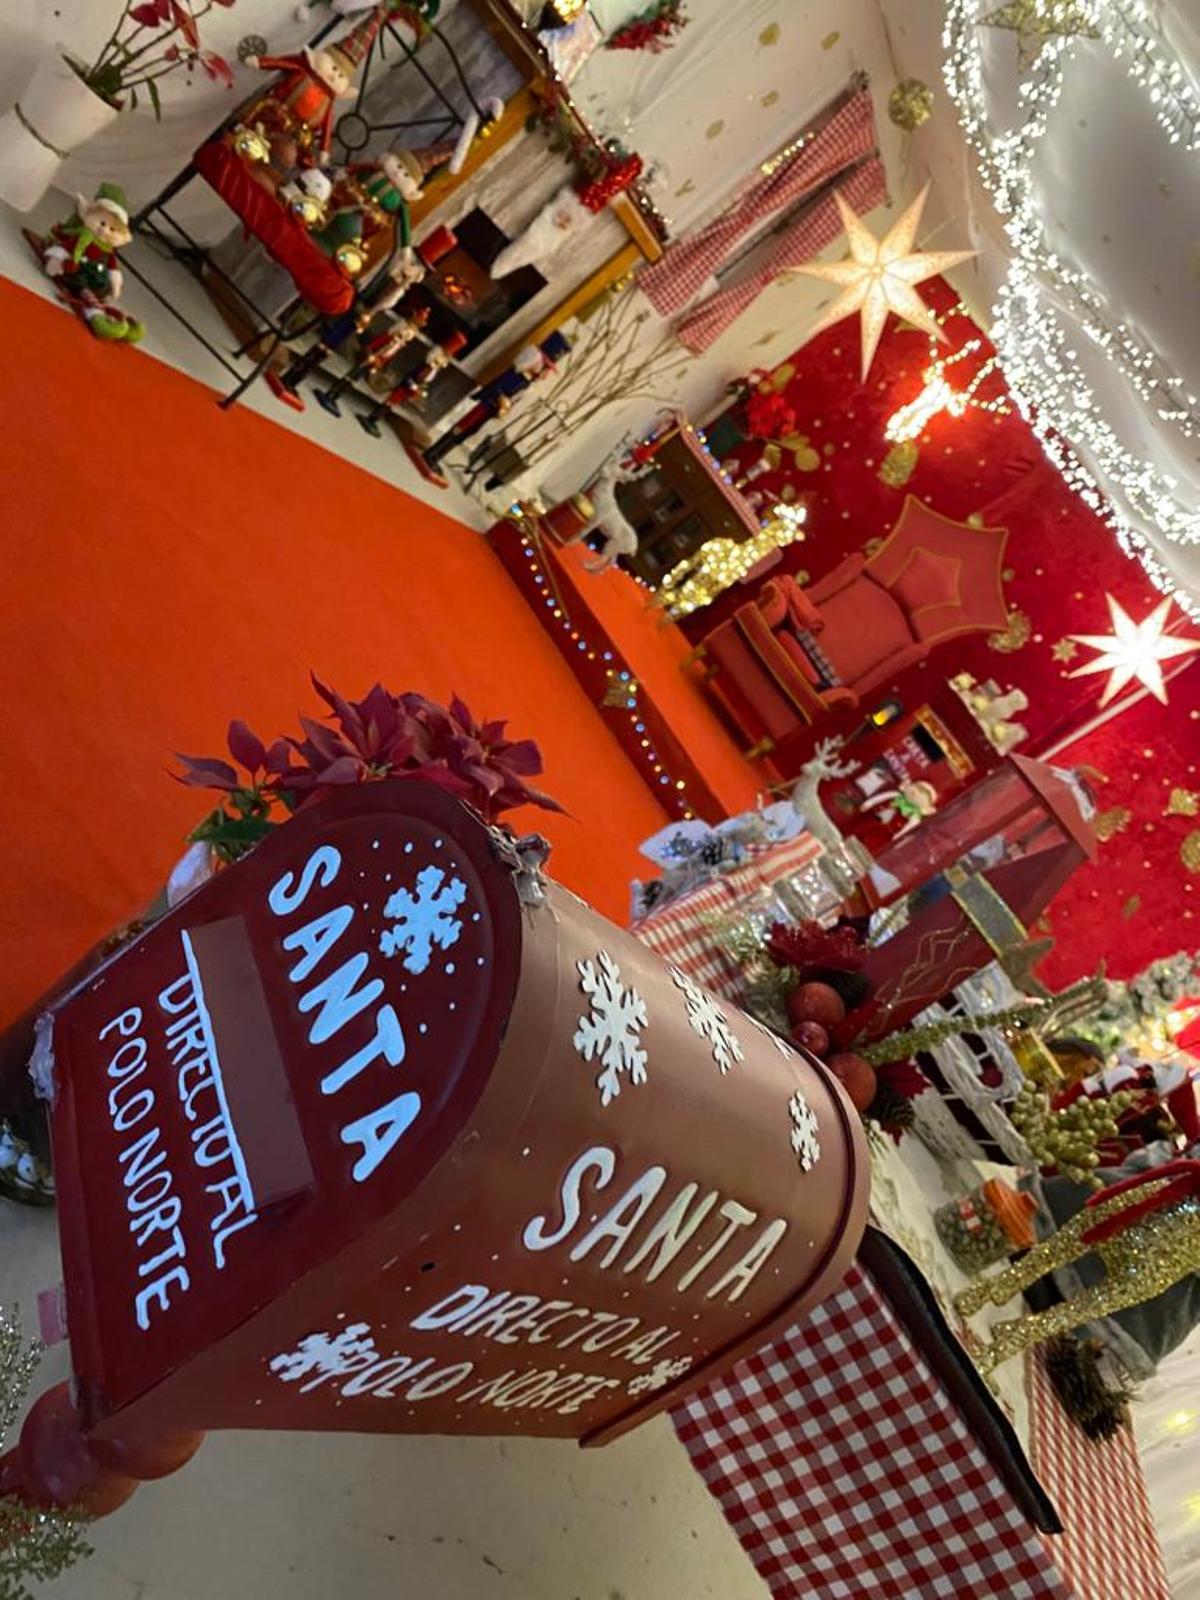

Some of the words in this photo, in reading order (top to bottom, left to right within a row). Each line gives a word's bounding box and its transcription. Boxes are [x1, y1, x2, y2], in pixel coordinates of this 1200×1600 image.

[100, 1007, 155, 1132] POLO
[268, 845, 421, 1182] SANTA
[118, 1127, 190, 1330] NORTE
[205, 1175, 258, 1270] AL
[523, 1146, 788, 1302] SANTA
[299, 1350, 474, 1401] POLO
[456, 1368, 621, 1415] NORTE
[410, 1284, 640, 1353] DIRECTO
[611, 1325, 681, 1365] AL
